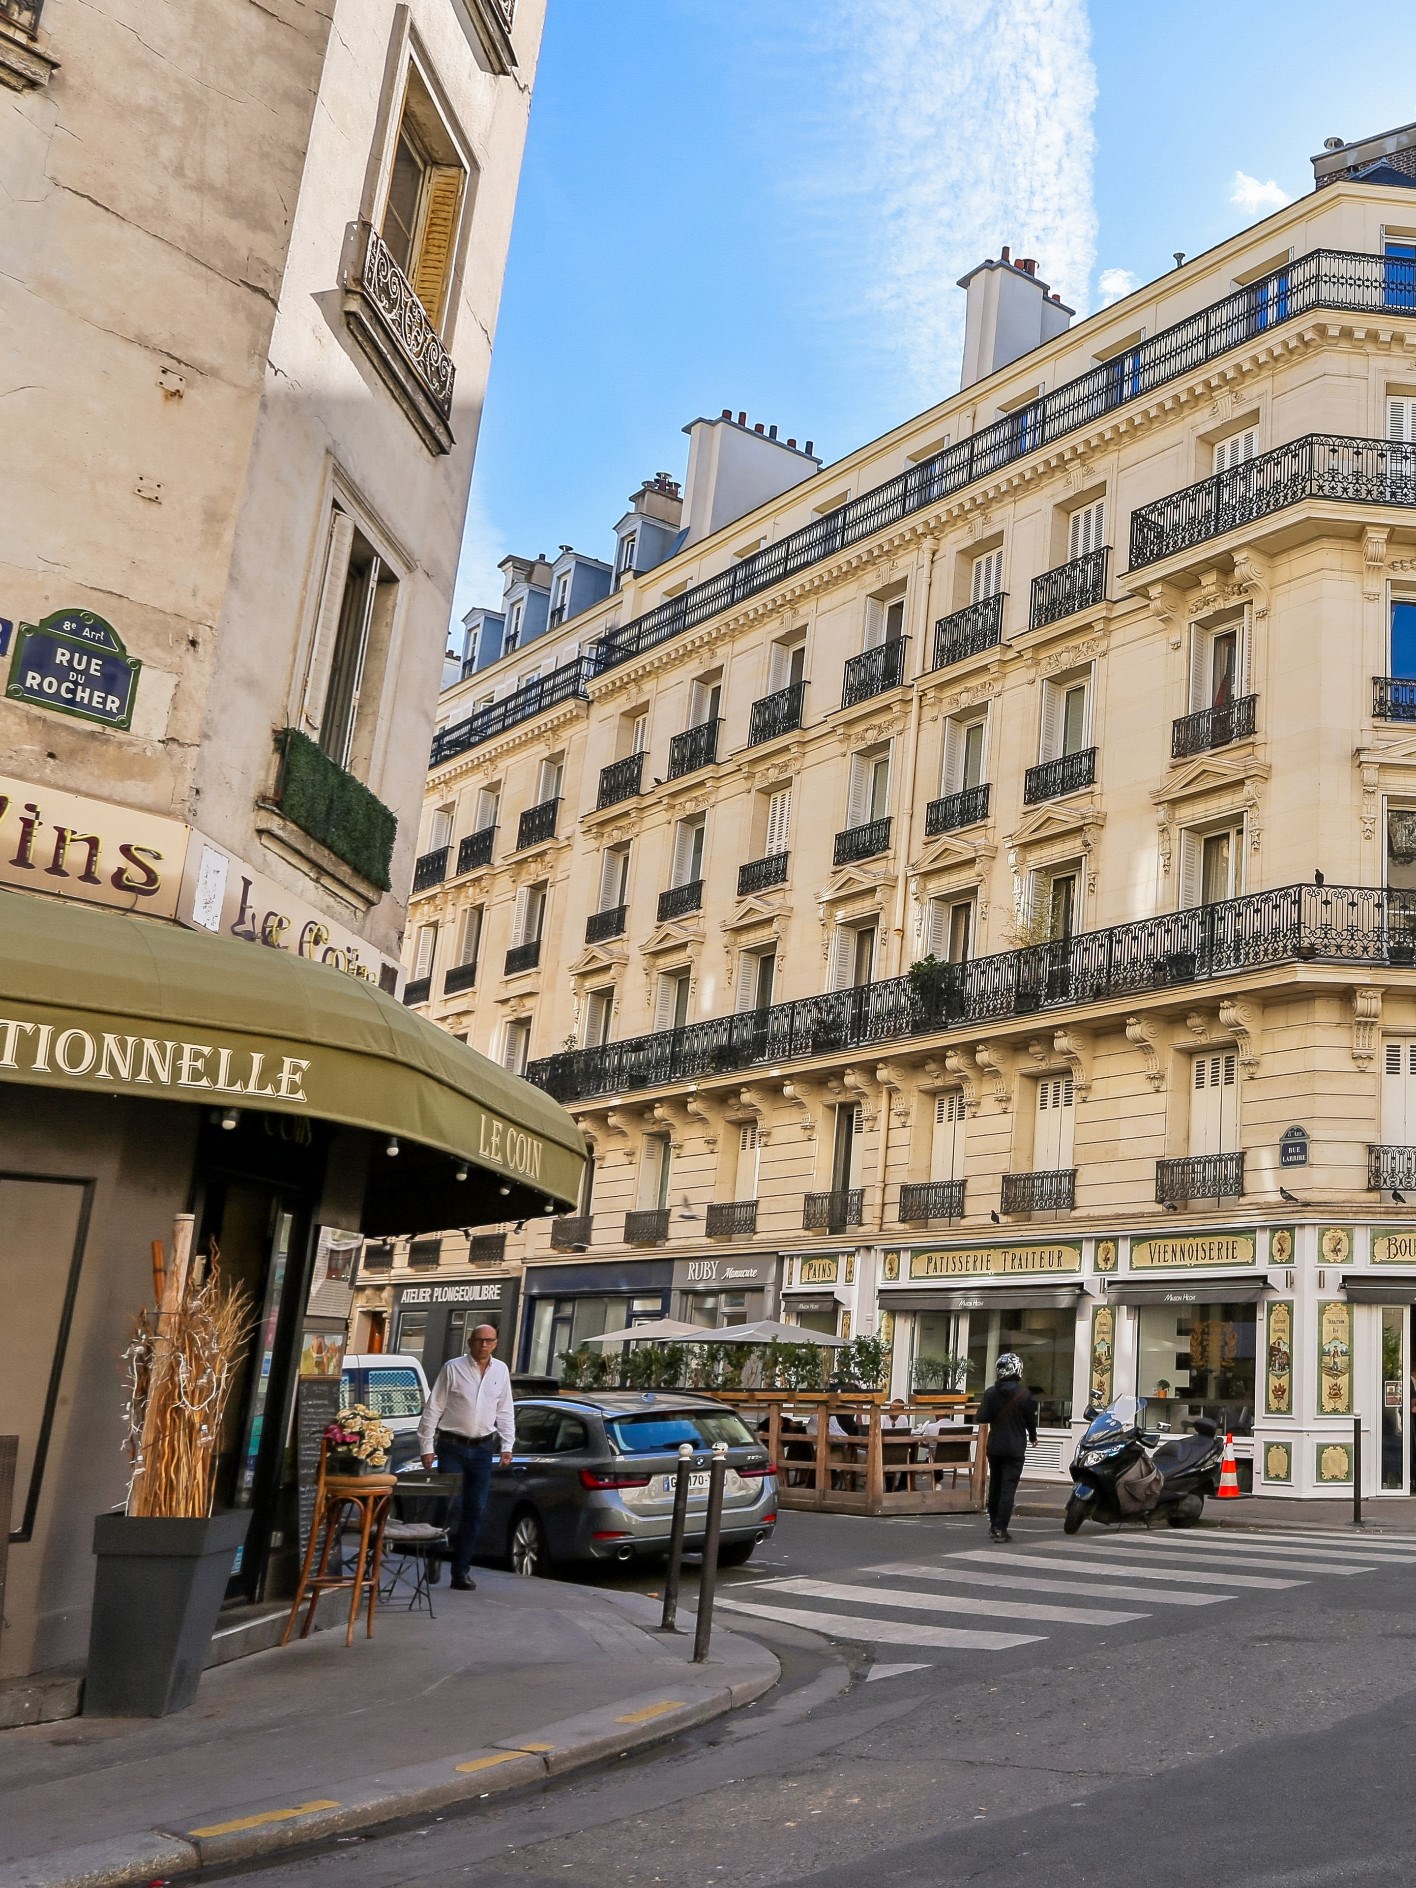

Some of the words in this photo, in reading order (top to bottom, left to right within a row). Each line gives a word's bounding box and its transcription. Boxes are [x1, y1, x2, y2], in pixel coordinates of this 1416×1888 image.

[55, 647, 103, 677] RUE
[69, 671, 86, 684] DU
[25, 670, 121, 714] ROCHER
[479, 1113, 504, 1165] LE
[506, 1127, 543, 1181] COIN
[925, 1253, 992, 1275] PATISSERIE
[1001, 1249, 1064, 1272] TRAITEUR
[1148, 1240, 1239, 1265] VIENNOISERIE
[687, 1260, 719, 1281] RUBY
[806, 1261, 833, 1281] PAINS
[400, 1288, 432, 1304] ATELIER
[433, 1285, 502, 1302] PLONGEQUILIBRE
